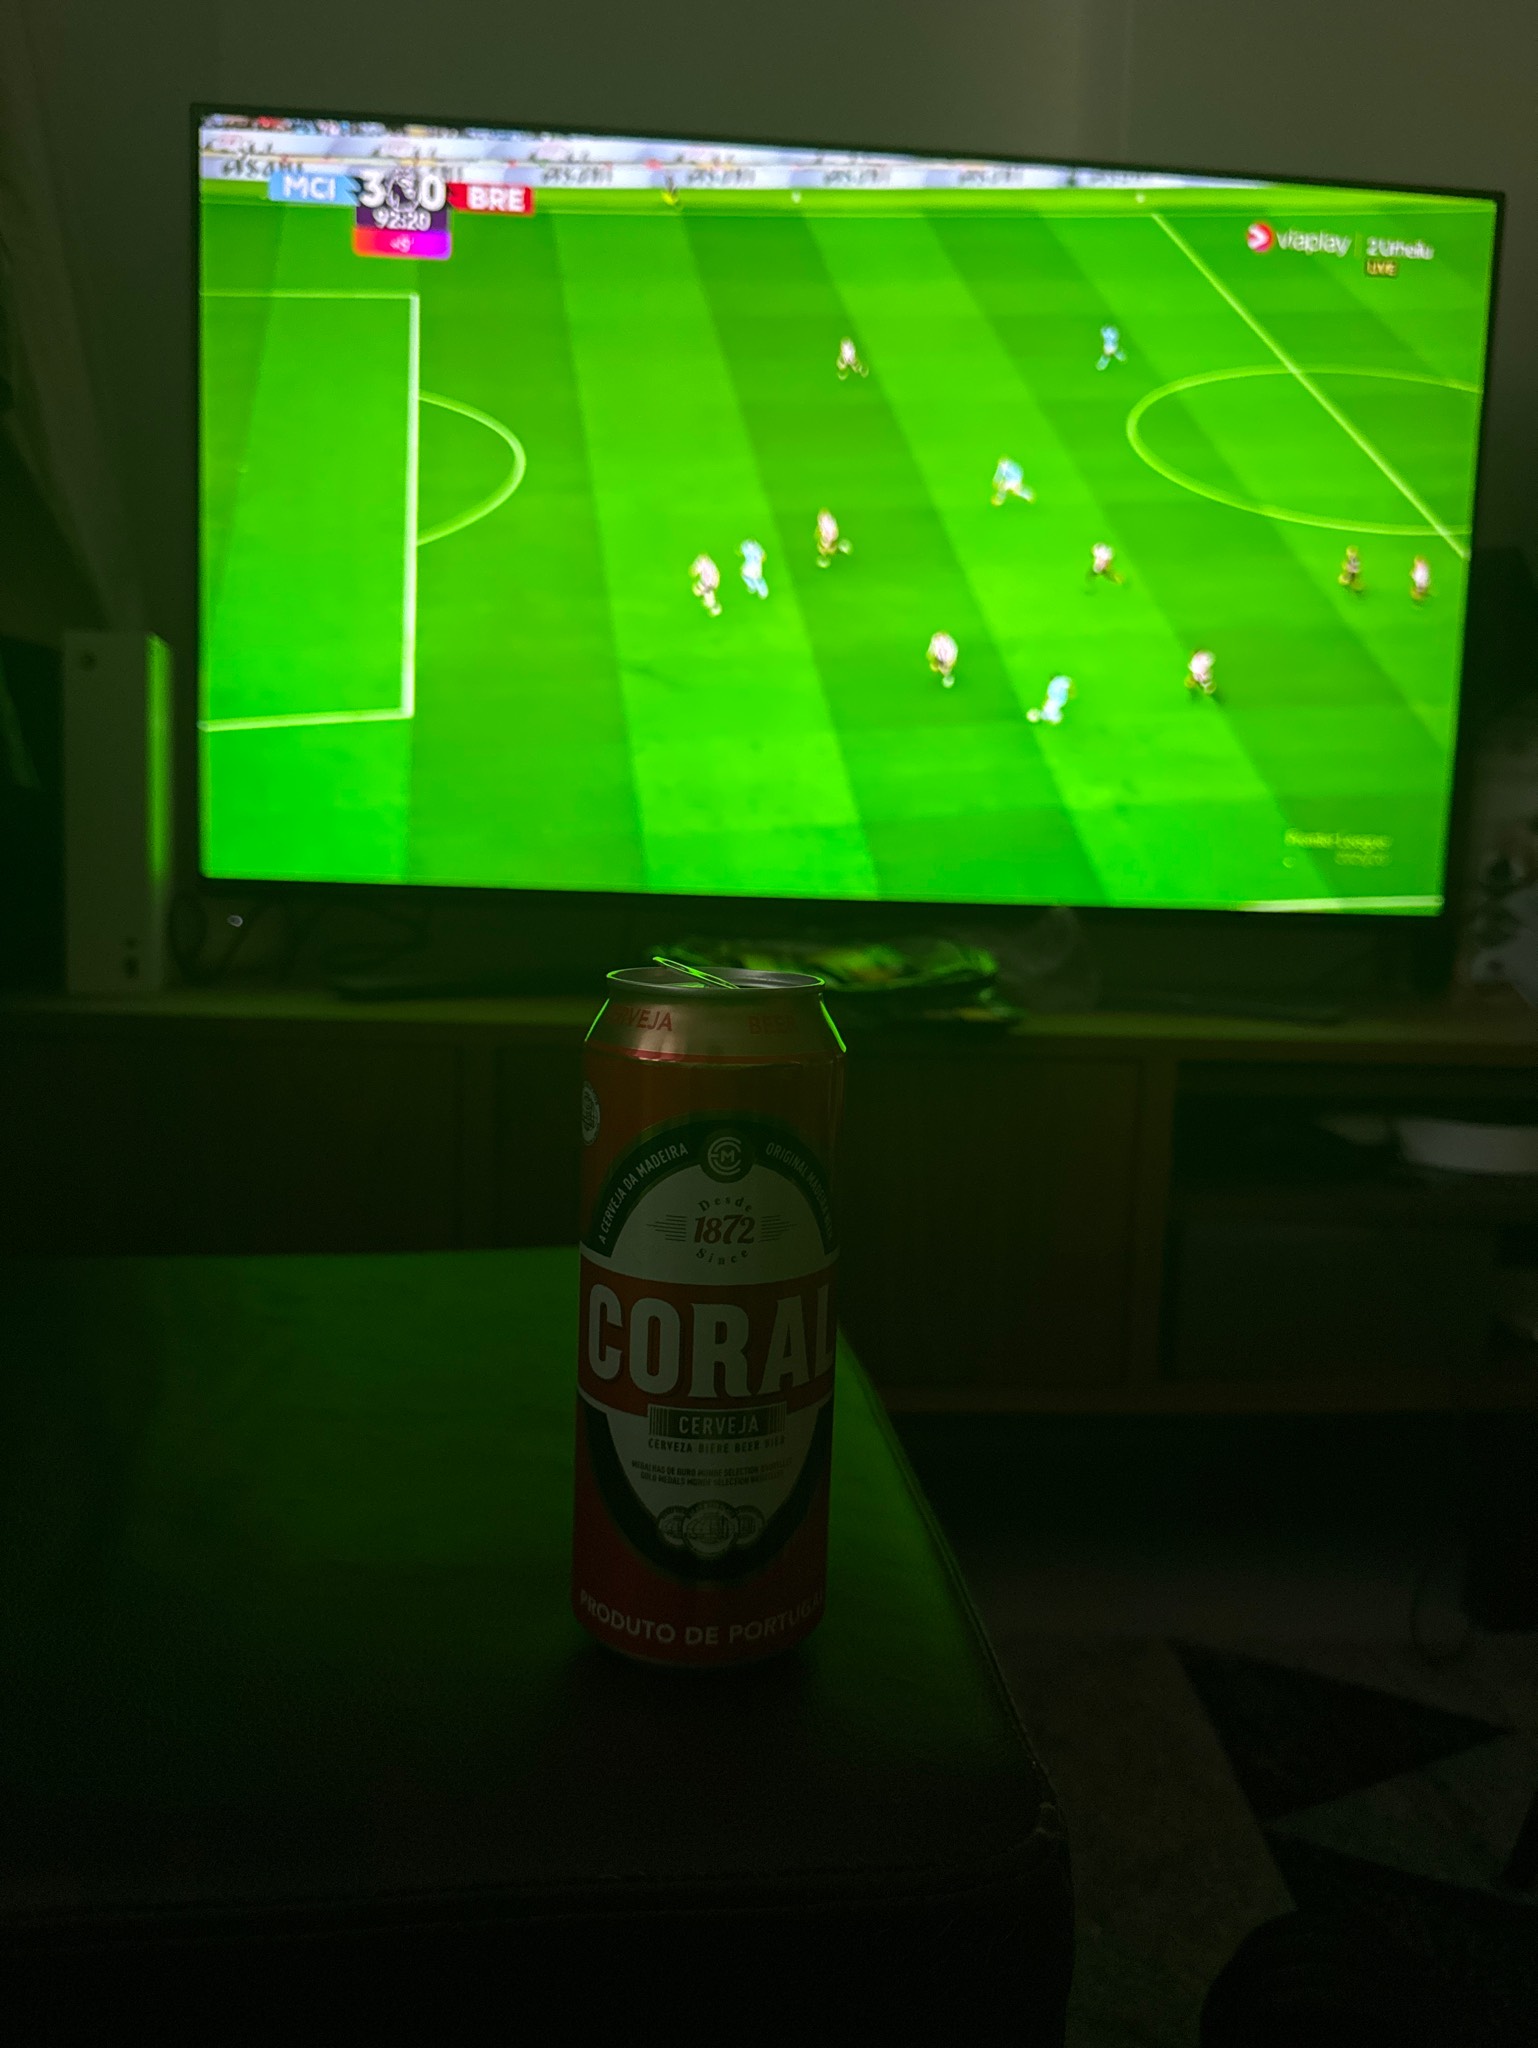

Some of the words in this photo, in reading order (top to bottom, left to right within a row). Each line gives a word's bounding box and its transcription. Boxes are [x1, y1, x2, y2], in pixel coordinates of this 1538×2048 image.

[282, 174, 336, 200] MCI
[358, 168, 387, 208] 3
[420, 174, 447, 211] 0
[466, 186, 526, 212] BRE
[1276, 229, 1352, 258] viaplay
[766, 1142, 809, 1178] ORIGINAL
[600, 1186, 627, 1234] CERVEJA
[622, 1172, 639, 1191] DA
[635, 1142, 689, 1178] MADEIRA
[698, 1196, 753, 1212] Desde
[694, 1214, 756, 1244] 1872
[696, 1248, 749, 1265] Since
[588, 1282, 835, 1398] CORAL
[678, 1416, 760, 1435] CERVEJA
[648, 1437, 692, 1453] CERVEZA
[734, 1440, 760, 1453] BEER
[579, 1588, 676, 1644] PRODUTO
[684, 1626, 720, 1645] DE
